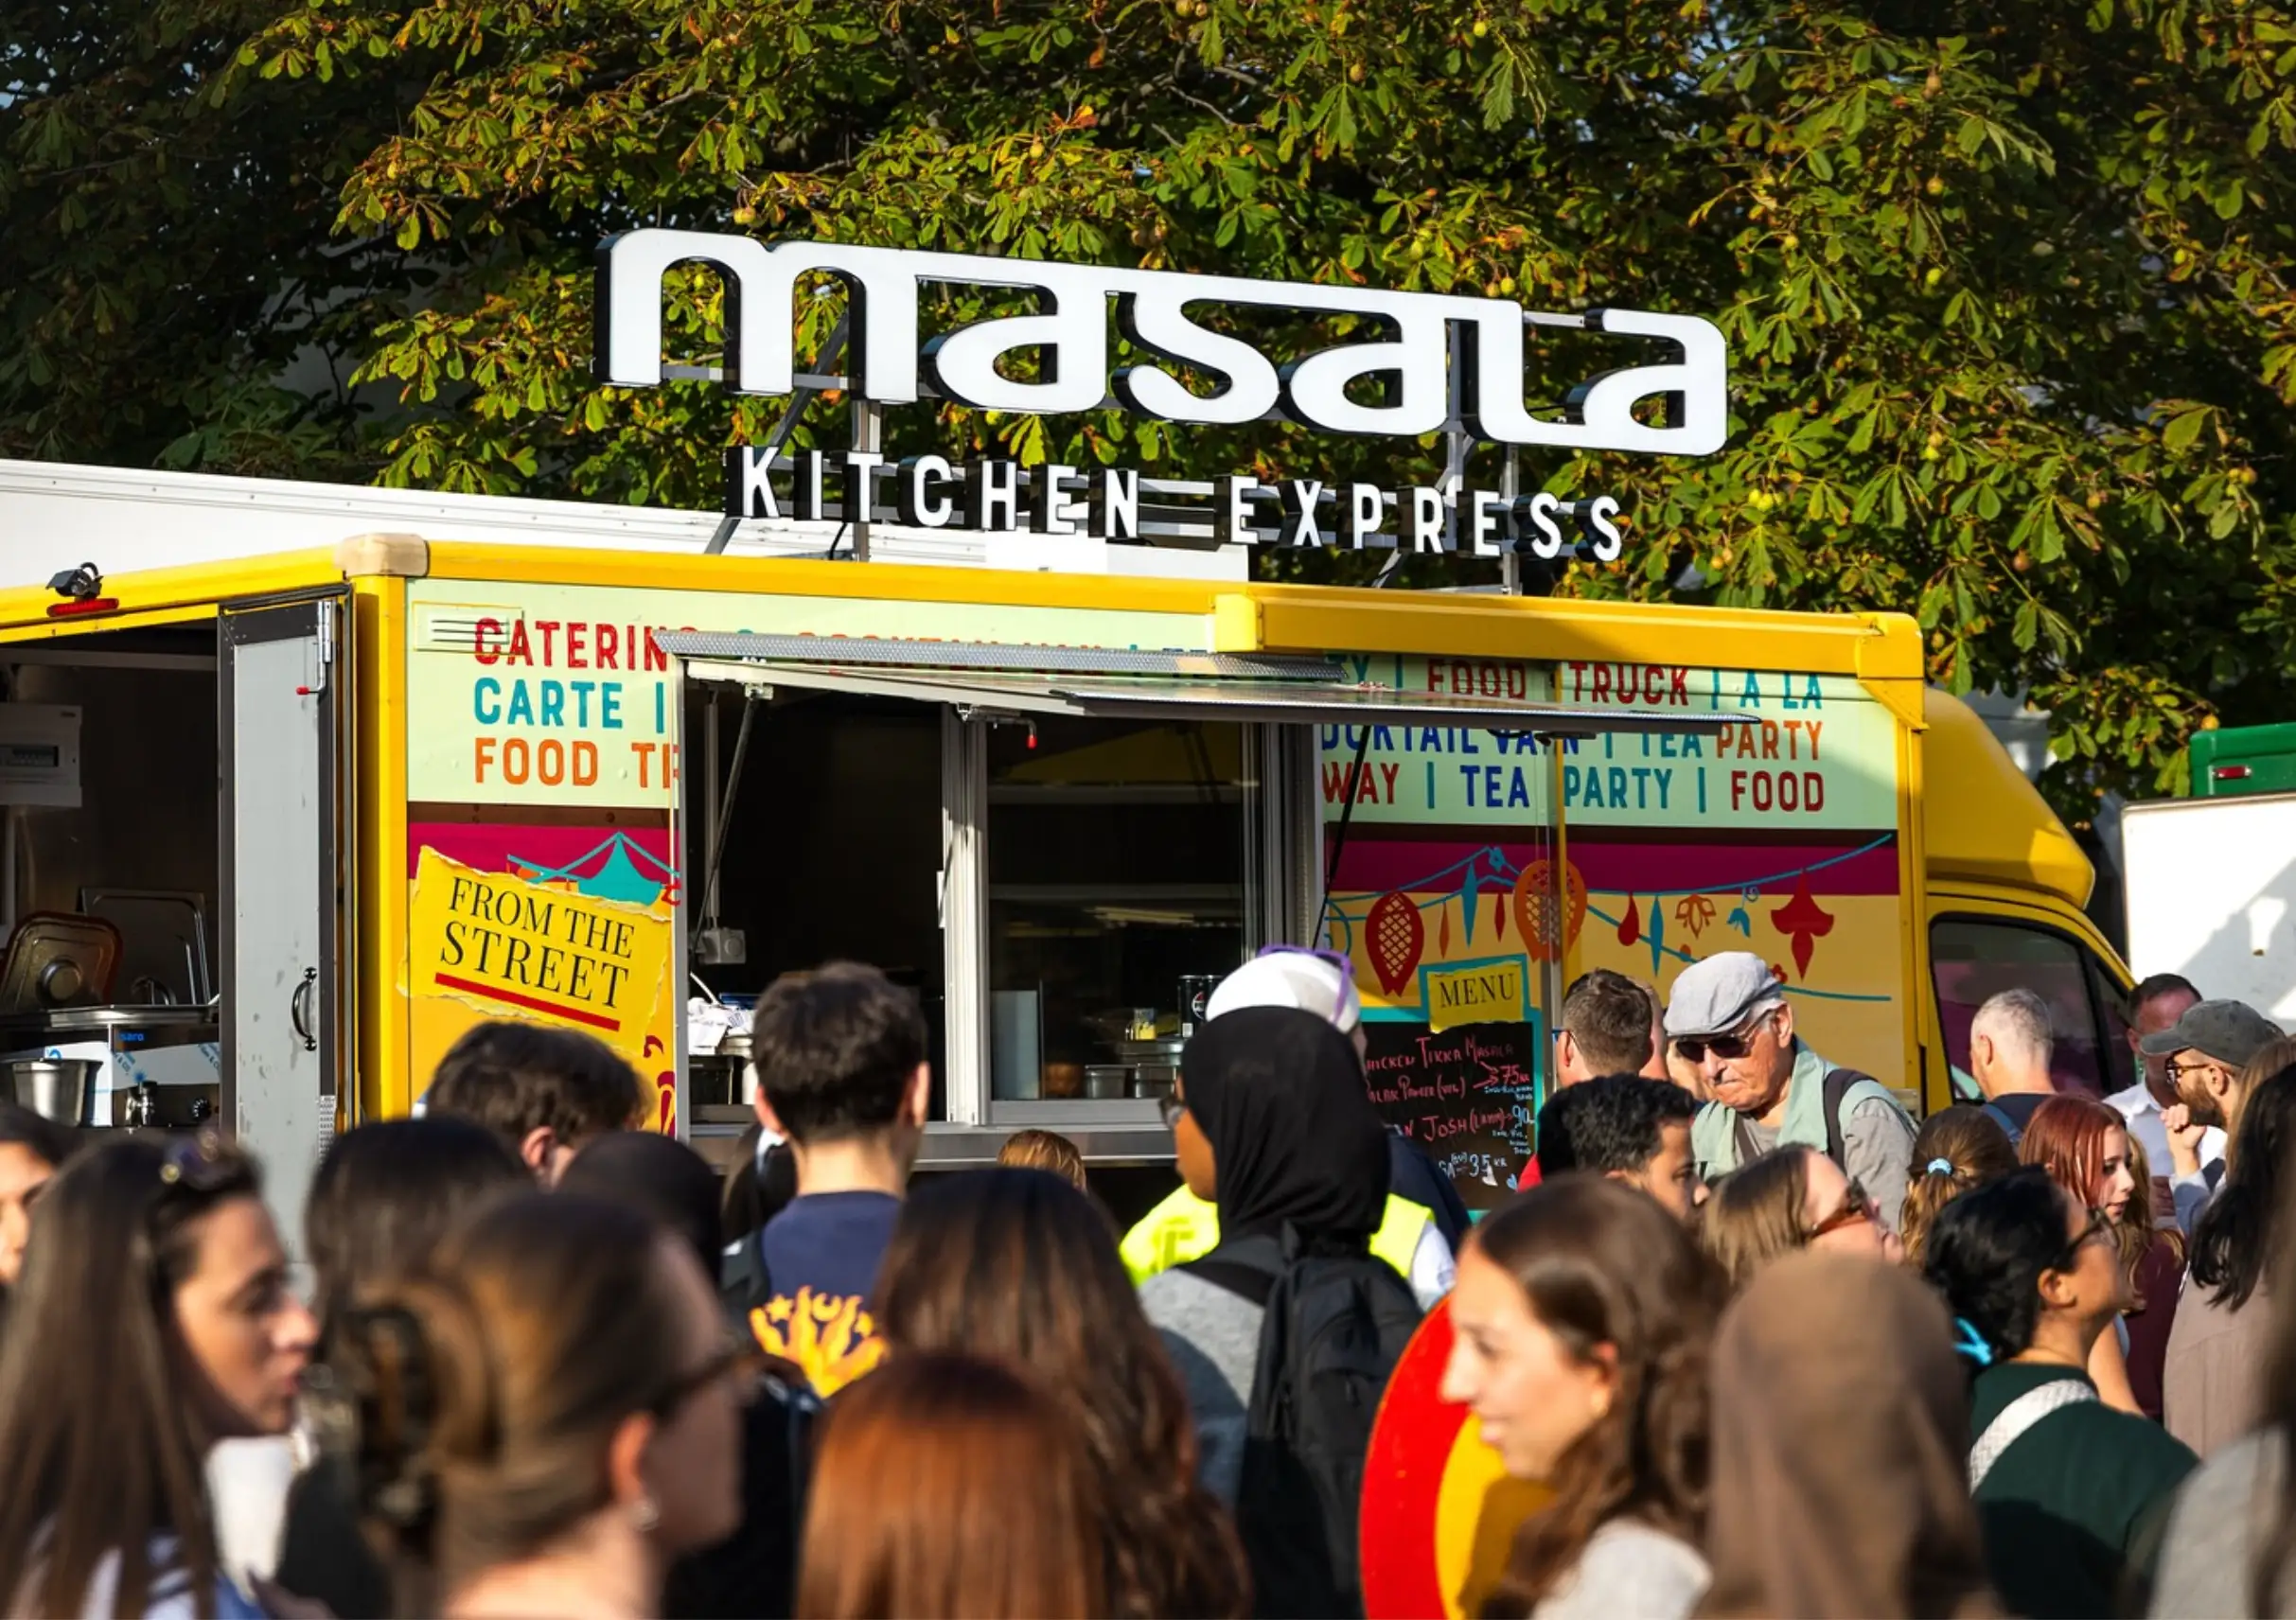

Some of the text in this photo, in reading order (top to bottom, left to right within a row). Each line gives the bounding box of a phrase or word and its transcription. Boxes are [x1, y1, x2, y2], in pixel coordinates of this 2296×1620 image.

[600, 228, 1728, 455] masala
[733, 446, 1624, 562] KITCHEN EXPRESS
[473, 617, 698, 673] CATERIN
[473, 677, 624, 729] CARTE
[1427, 659, 1527, 700] FOOD
[1568, 661, 1690, 706] TRUCK
[1740, 669, 1761, 709] A
[1782, 671, 1824, 710] LA
[474, 737, 598, 786] FOOD
[1321, 724, 1479, 754] OCKTAIL
[1641, 731, 1703, 758] TEA
[1716, 719, 1824, 761] PARTY
[1459, 765, 1530, 808] TEA
[1563, 765, 1673, 809] PARTY
[1730, 770, 1825, 812] FOOD
[448, 876, 635, 959] FROM THE
[439, 921, 629, 1010] STREET
[1439, 973, 1515, 1009] MENU
